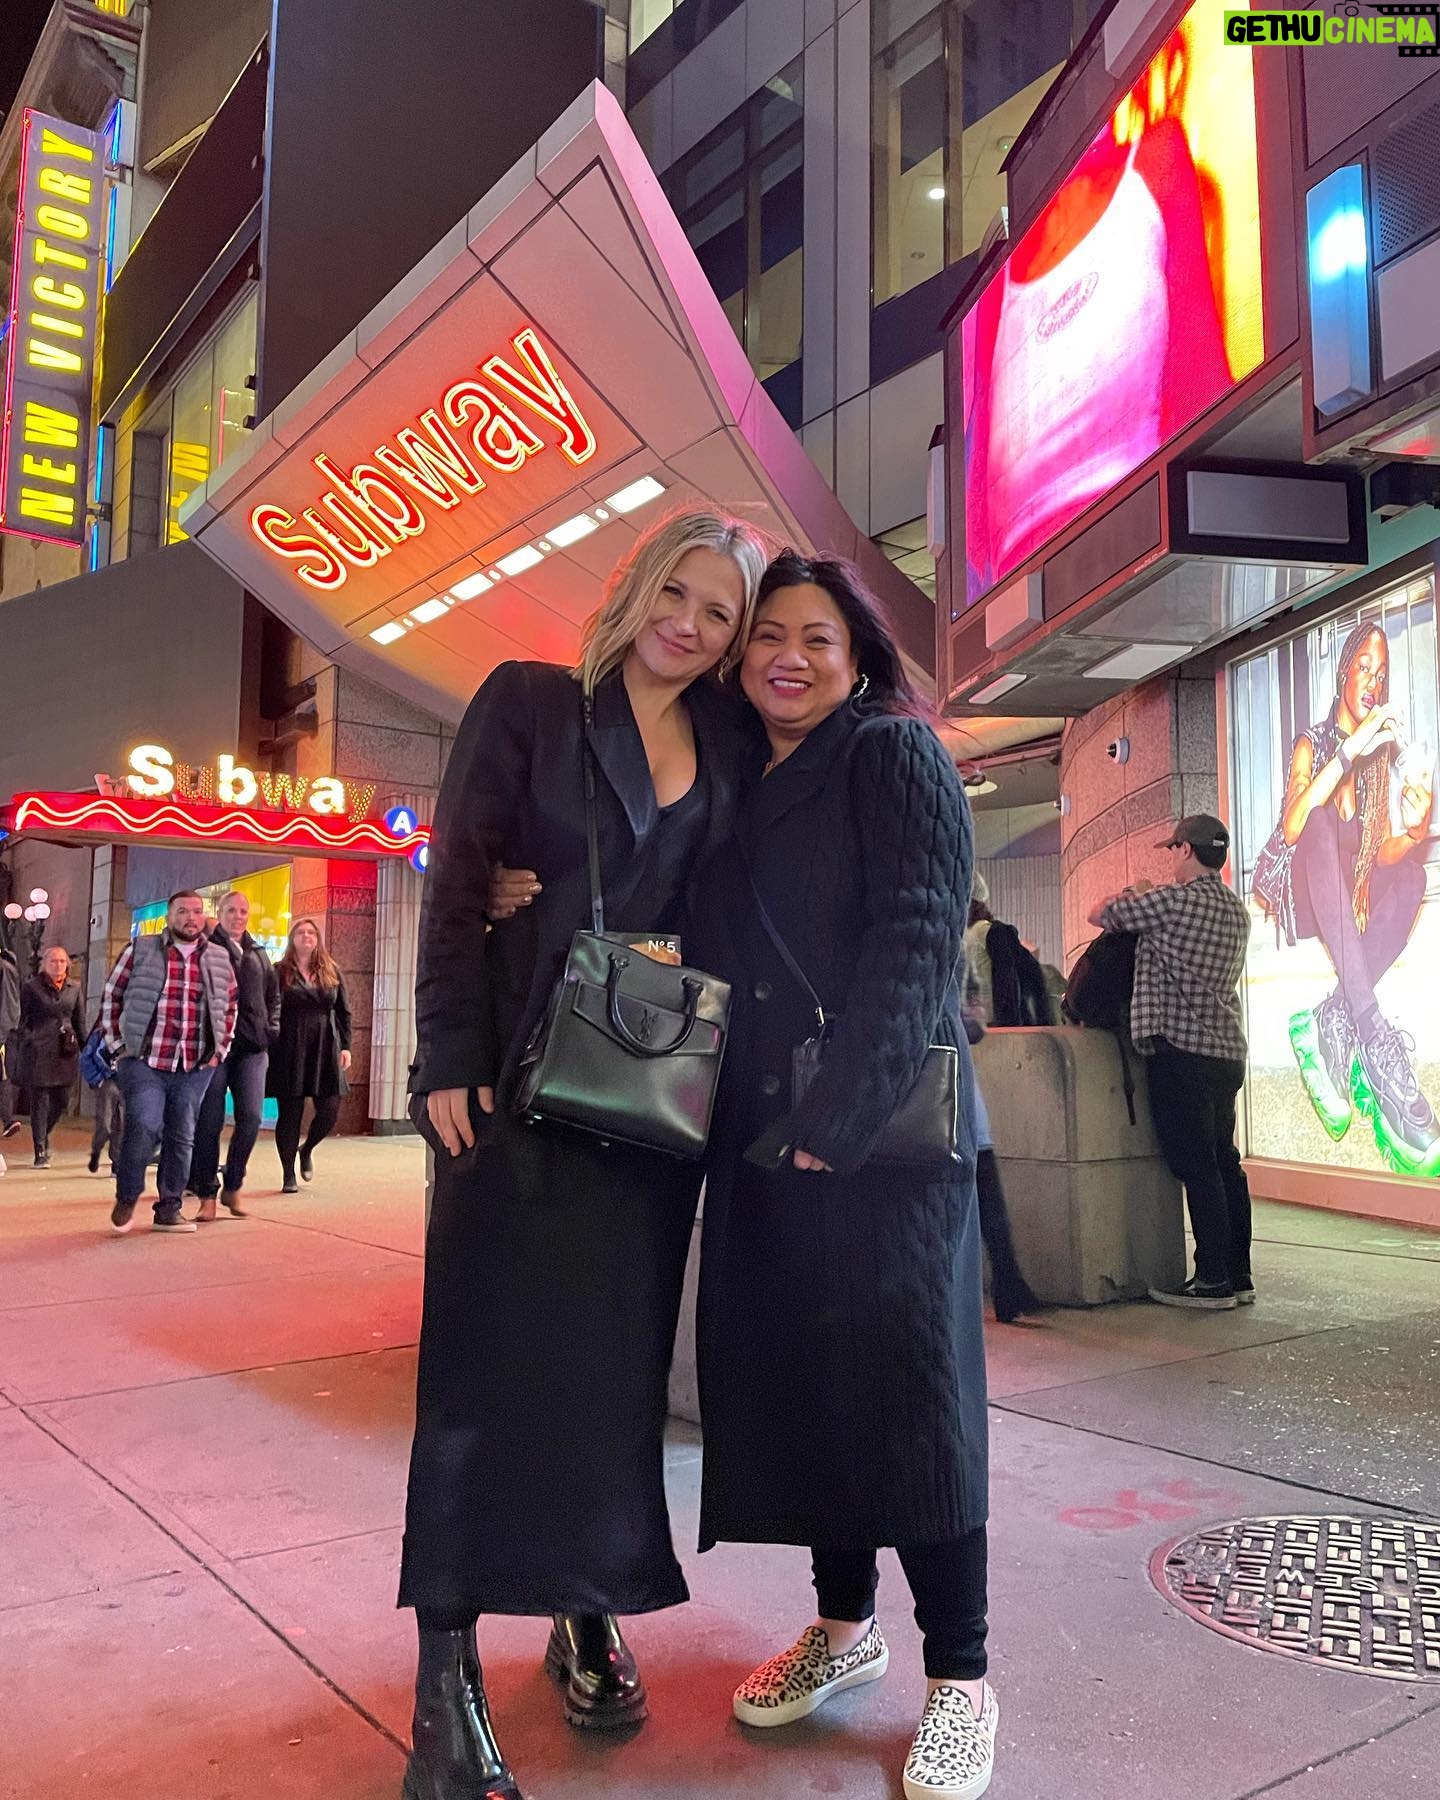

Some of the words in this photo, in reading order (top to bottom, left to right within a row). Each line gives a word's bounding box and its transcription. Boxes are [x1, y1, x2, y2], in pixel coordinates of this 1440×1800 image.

[28, 128, 94, 372] VICTORY
[21, 401, 79, 526] NEW
[250, 327, 598, 591] Subway
[127, 744, 376, 823] Subway
[391, 810, 412, 834] A
